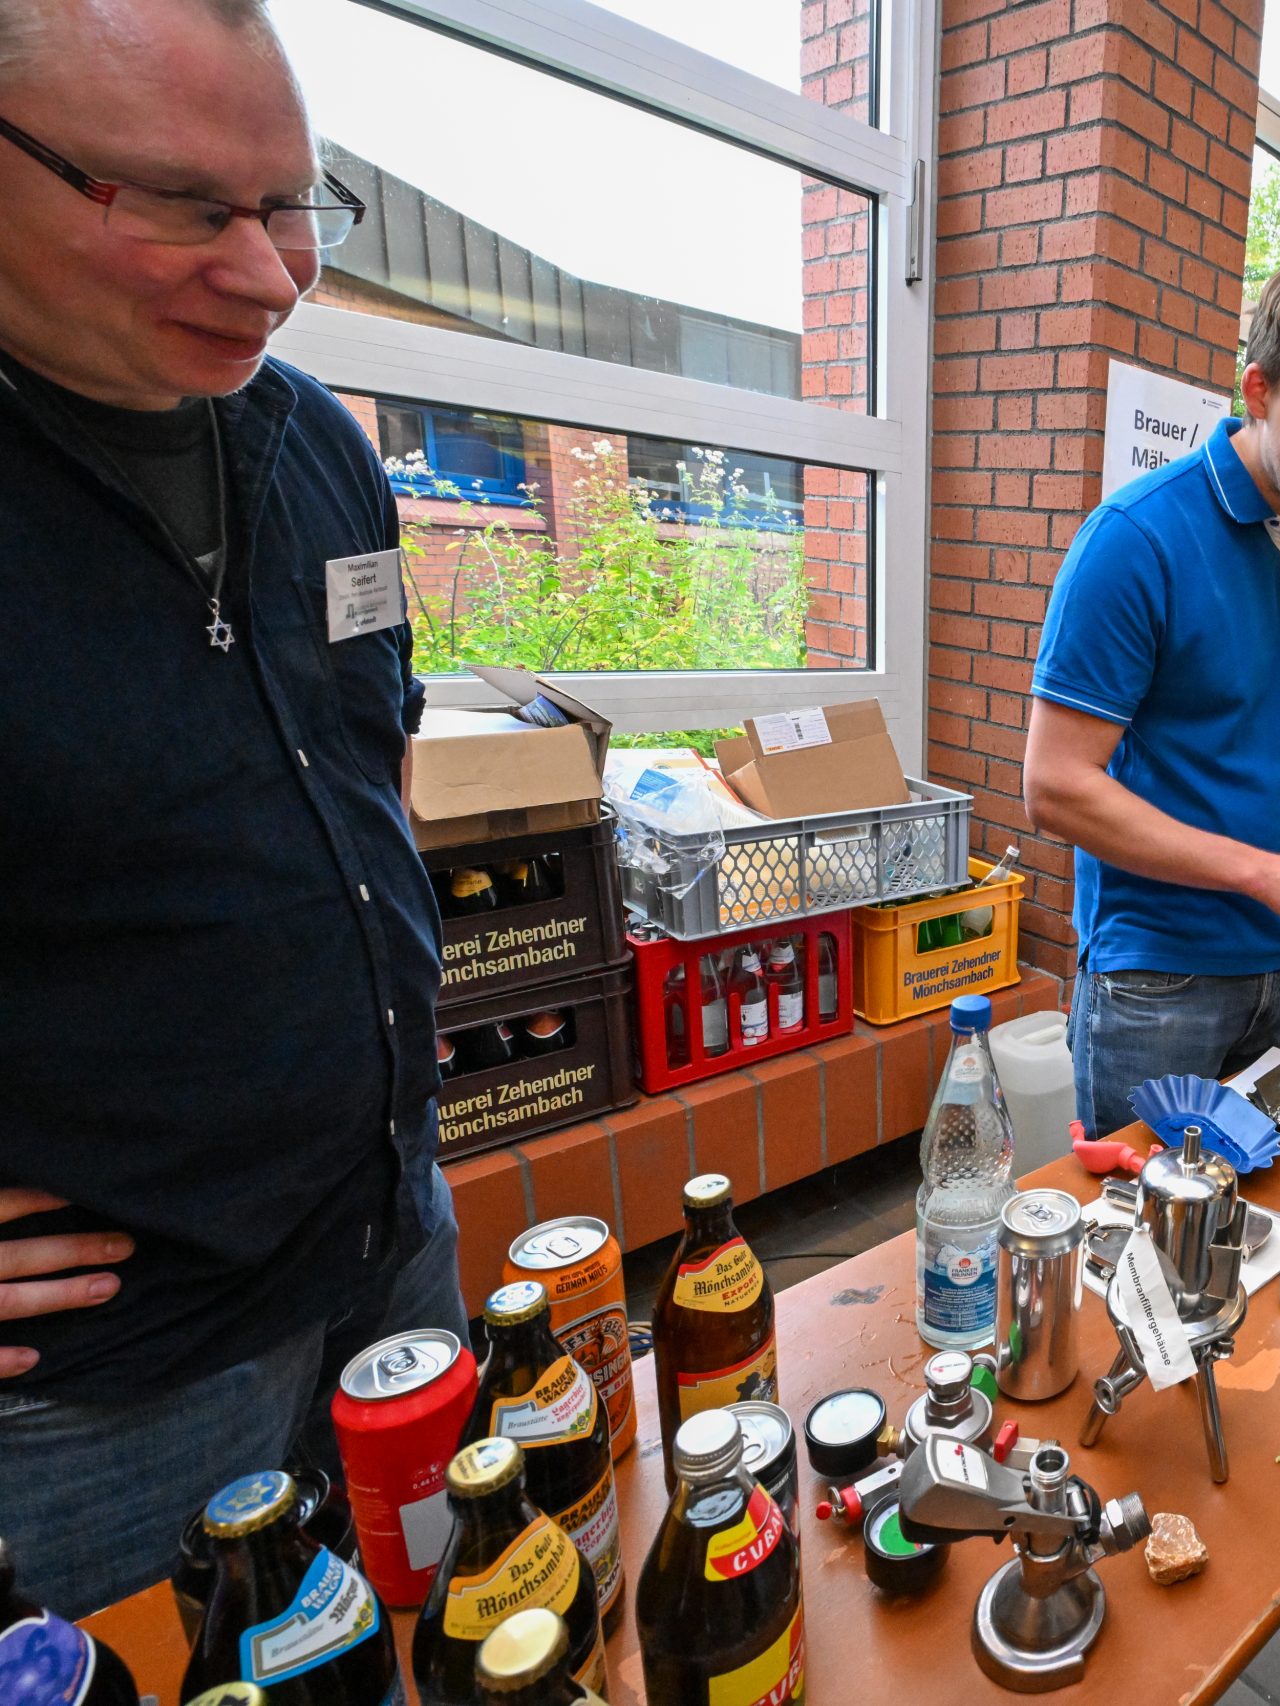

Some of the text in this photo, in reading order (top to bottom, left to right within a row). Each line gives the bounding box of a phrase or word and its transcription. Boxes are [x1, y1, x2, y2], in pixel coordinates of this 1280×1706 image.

[1134, 408, 1199, 448] Brauer /
[347, 560, 378, 572] Maximilian
[351, 573, 377, 587] Seifert
[442, 917, 587, 961] erei Zehendner
[903, 950, 1002, 986] Brauerei Zehendner
[912, 966, 994, 1000] Mönchsambach
[497, 1064, 596, 1105] Zehendner
[1126, 1252, 1171, 1366] Membranfiltergehäuse
[509, 1561, 534, 1583] Das
